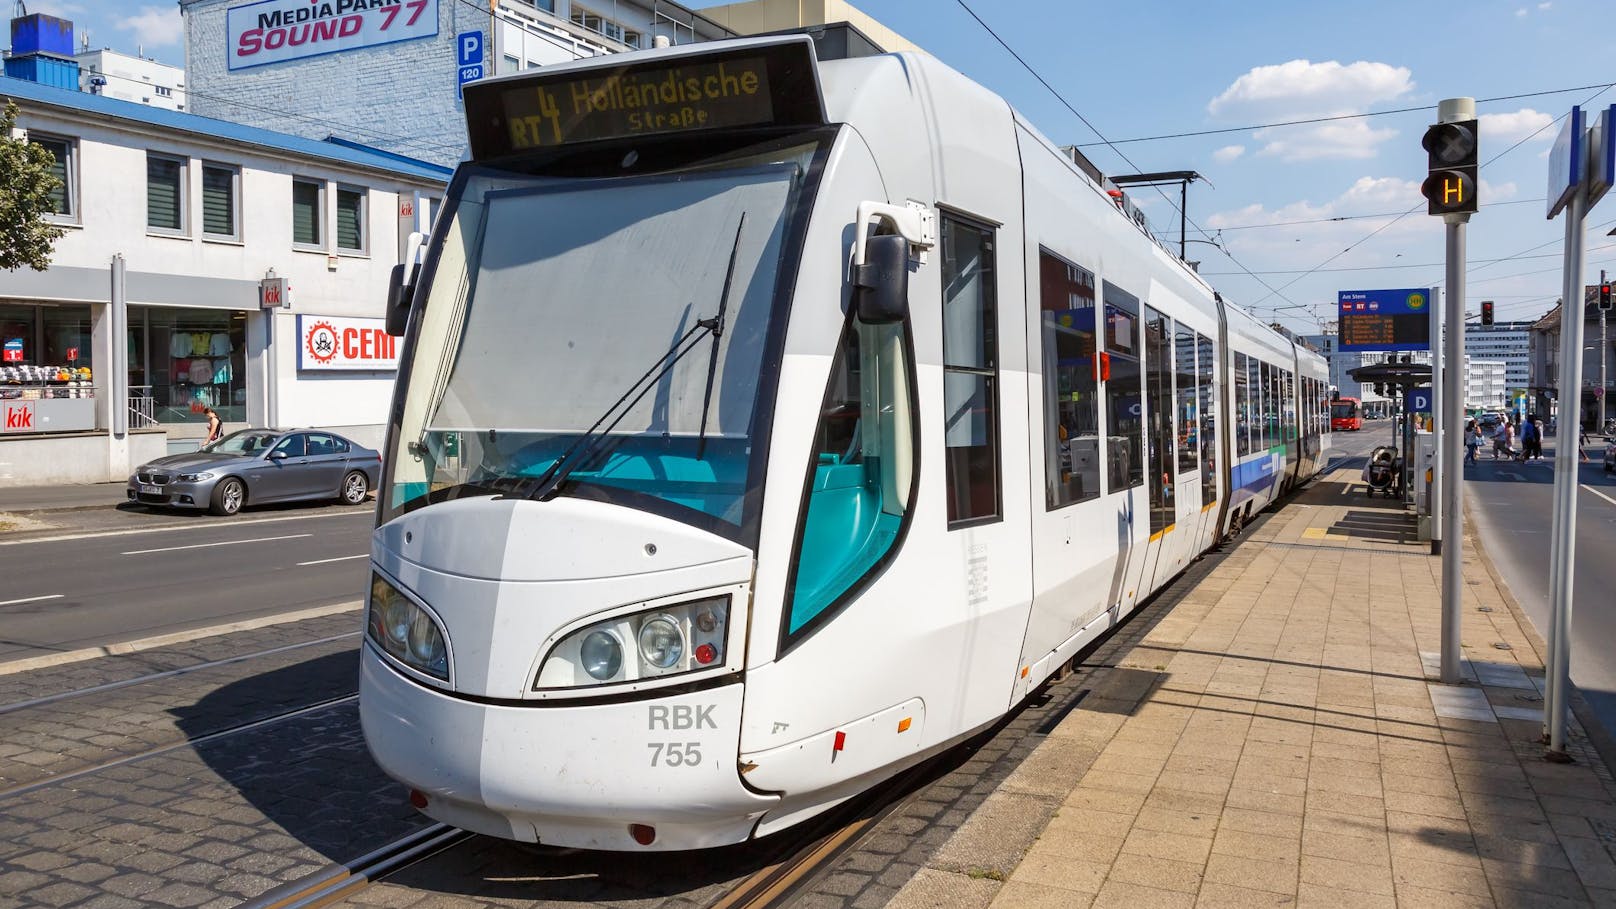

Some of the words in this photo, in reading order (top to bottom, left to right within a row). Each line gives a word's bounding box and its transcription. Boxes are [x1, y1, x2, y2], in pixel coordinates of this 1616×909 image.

[237, 15, 364, 57] SOUND
[379, 0, 428, 31] 77
[463, 37, 478, 61] P
[462, 68, 479, 79] 120
[571, 63, 759, 114] Holländische
[629, 107, 708, 130] Straße
[1444, 177, 1463, 204] H
[343, 327, 395, 360] CEM
[1415, 396, 1427, 409] D
[648, 704, 718, 730] RBK
[647, 742, 702, 767] 755
